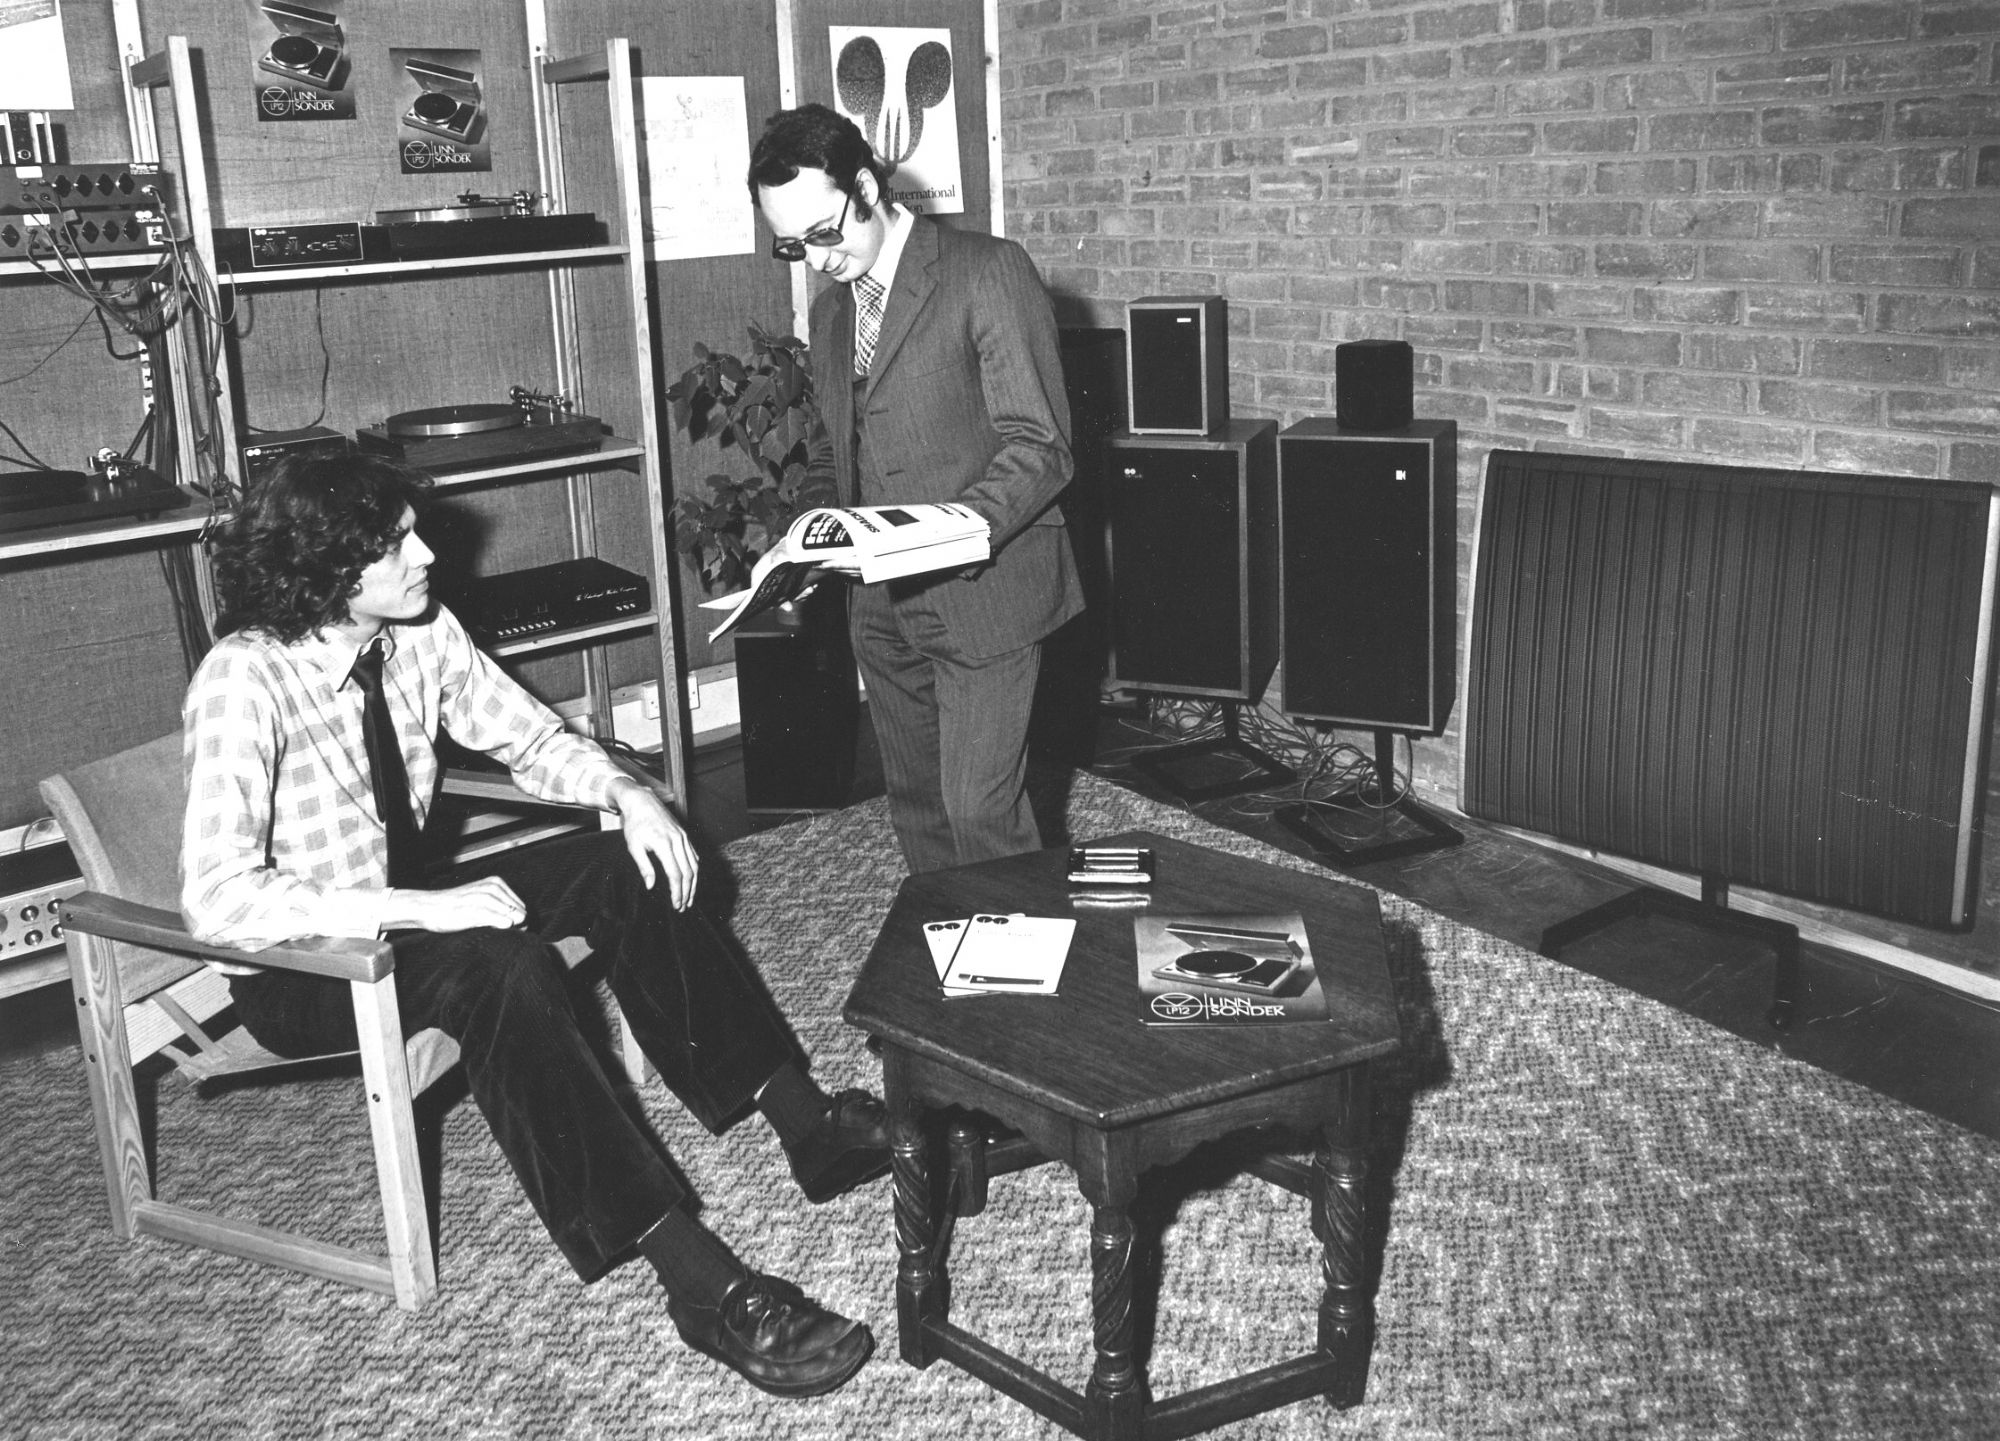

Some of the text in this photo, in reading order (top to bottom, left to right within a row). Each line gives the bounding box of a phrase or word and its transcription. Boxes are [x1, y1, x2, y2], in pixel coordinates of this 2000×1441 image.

[294, 91, 317, 101] LINN
[294, 101, 335, 111] SONDEK
[434, 145, 455, 154] LINN
[434, 153, 472, 164] SONDEK
[890, 184, 956, 201] International
[1209, 997, 1251, 1007] LINN
[1166, 1006, 1191, 1015] LP12
[1210, 1005, 1286, 1016] SONDEK
